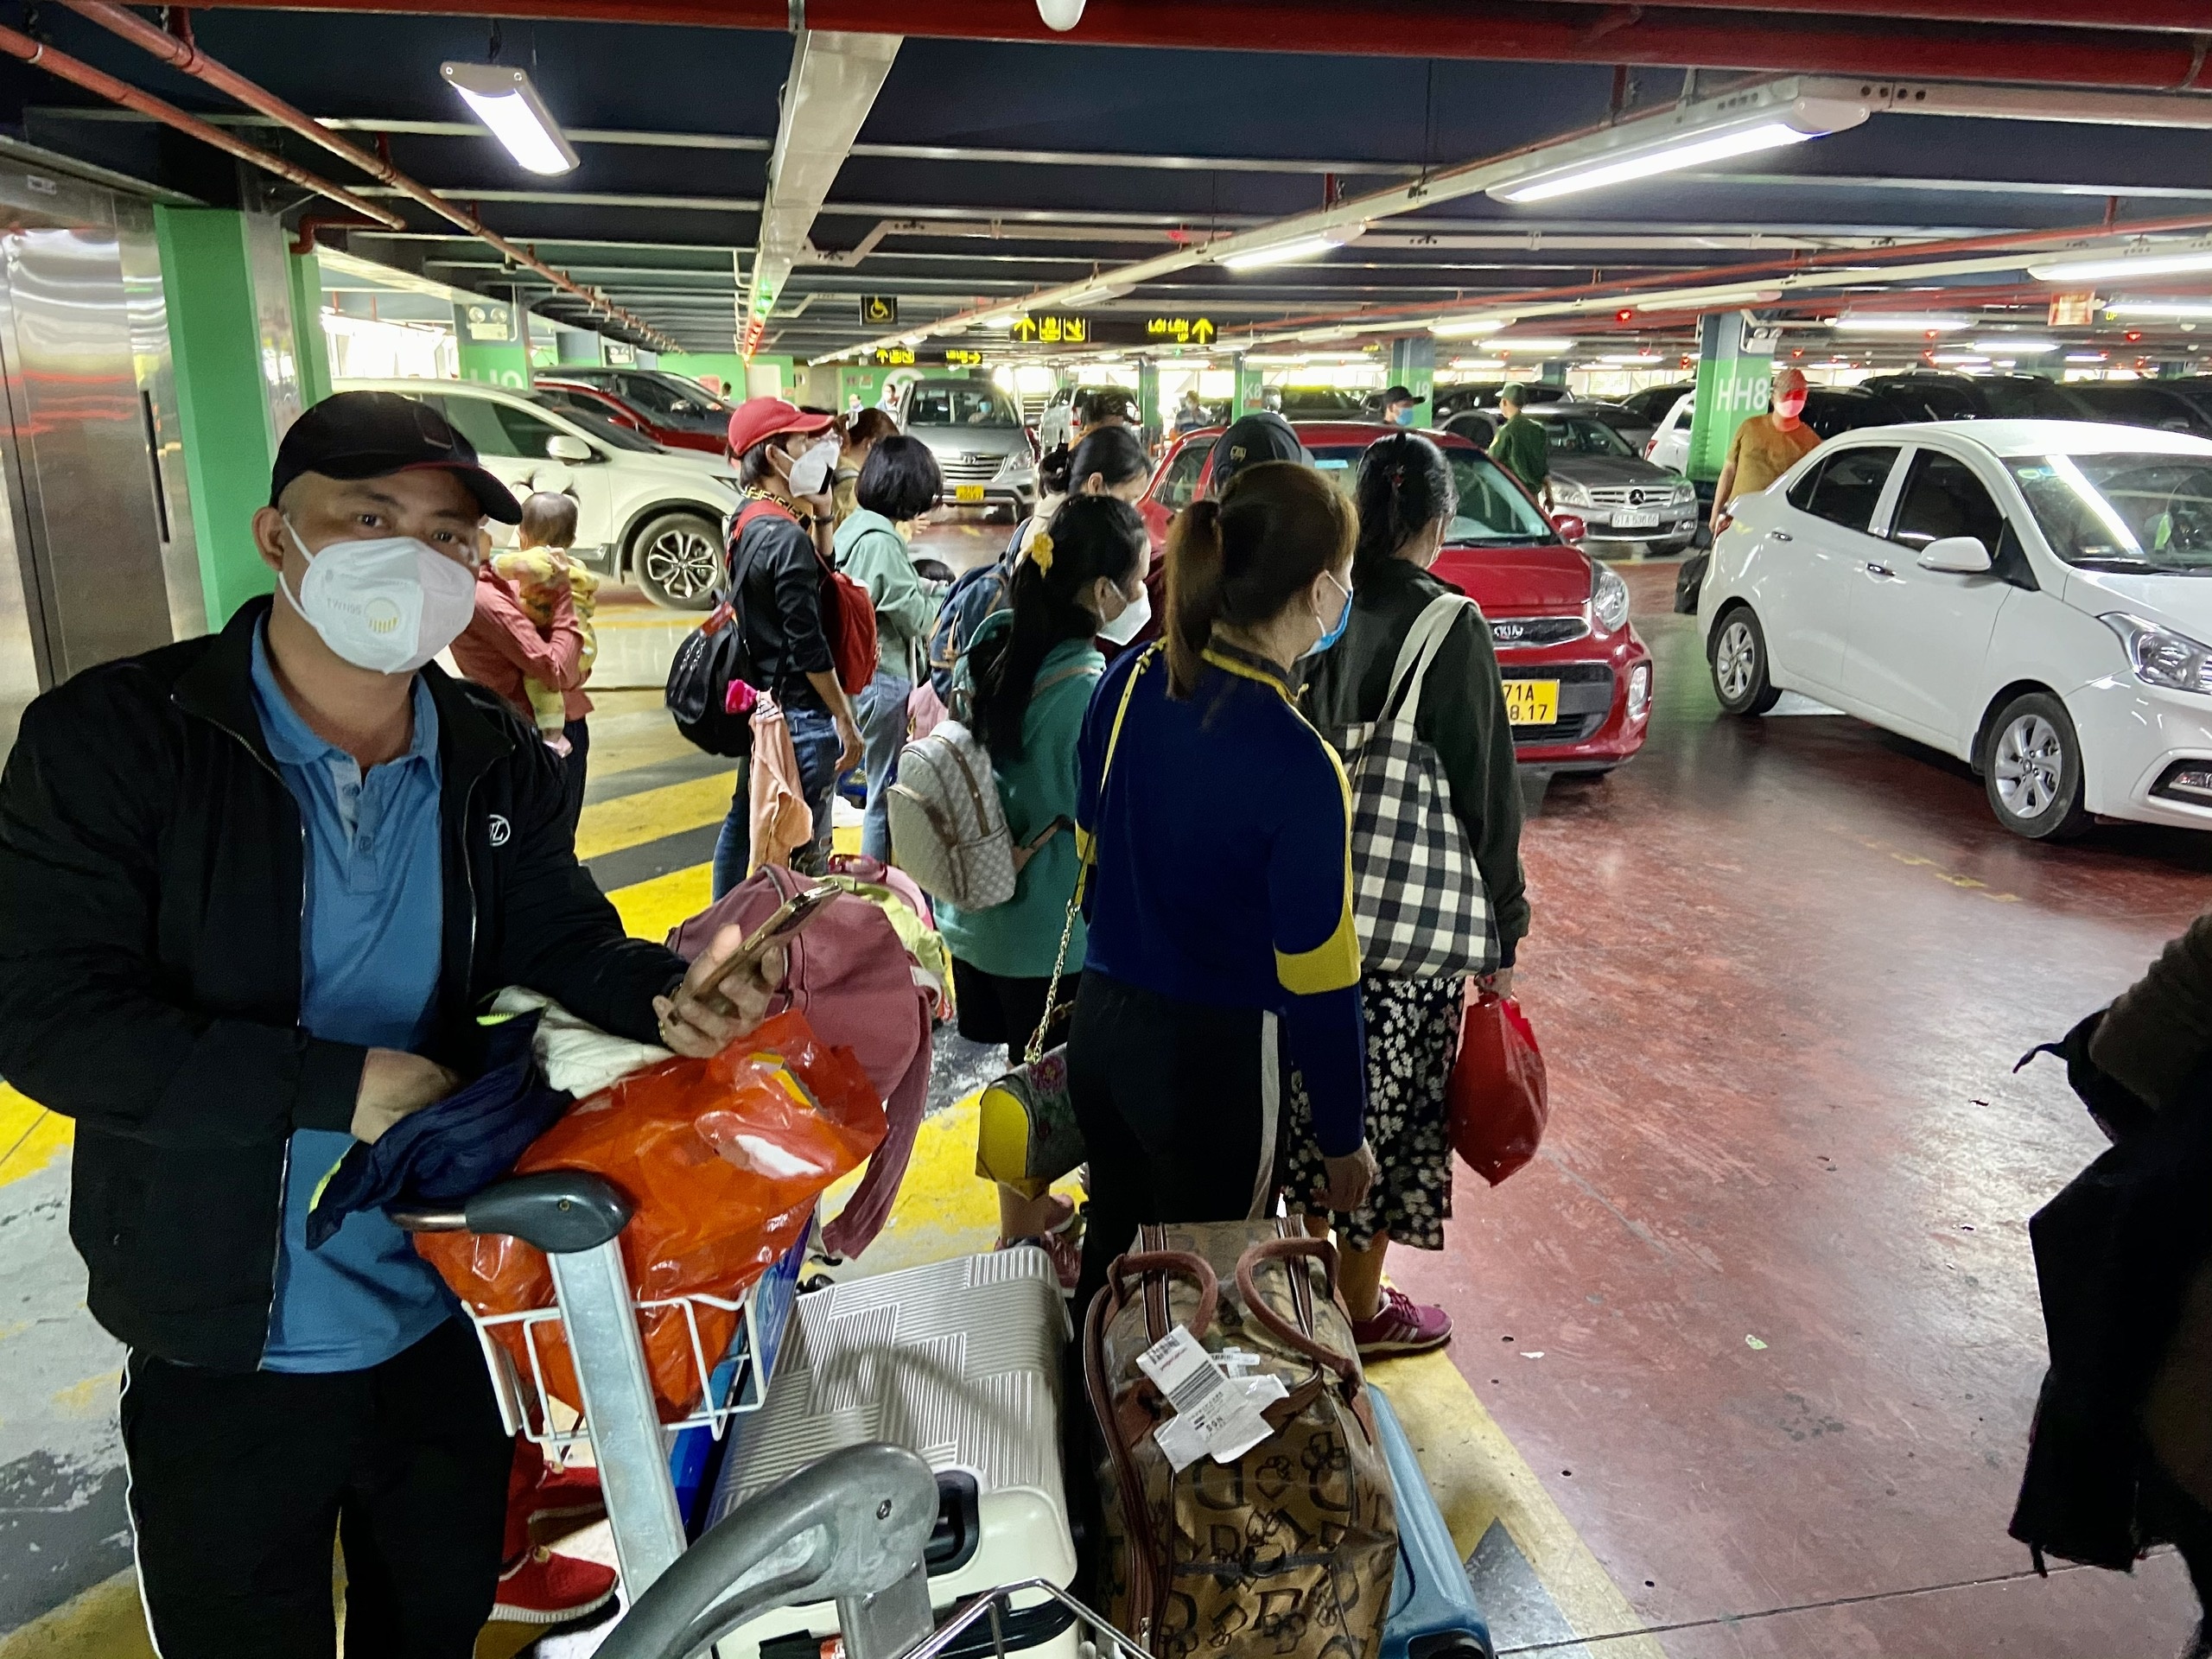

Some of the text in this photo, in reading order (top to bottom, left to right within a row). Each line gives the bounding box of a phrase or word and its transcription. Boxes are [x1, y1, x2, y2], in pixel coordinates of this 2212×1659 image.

[1177, 333, 1189, 342] UP
[1243, 383, 1262, 399] K8
[1716, 377, 1769, 411] HH8
[1503, 683, 1534, 702] 71A
